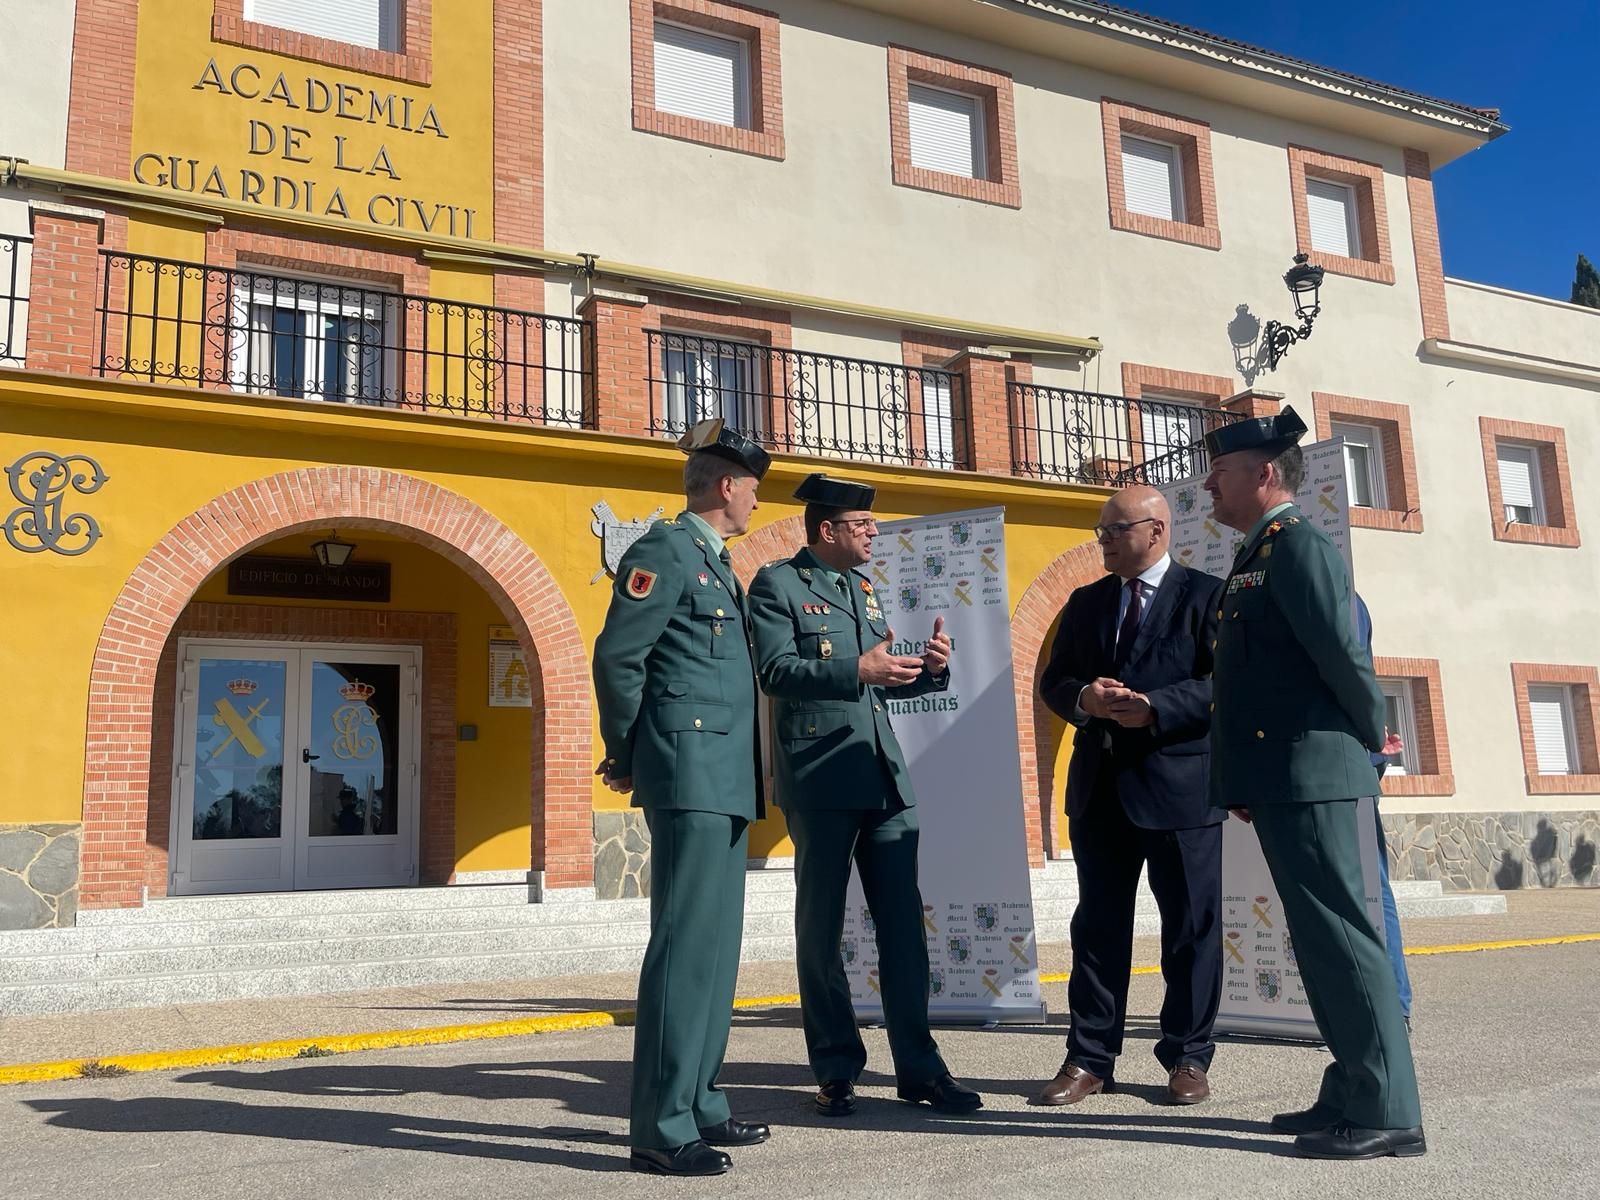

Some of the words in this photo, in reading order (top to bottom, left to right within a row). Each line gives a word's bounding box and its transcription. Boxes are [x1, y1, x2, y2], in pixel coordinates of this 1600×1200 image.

[192, 57, 450, 139] ACADEMIA
[248, 119, 314, 164] DE
[334, 135, 402, 181] LA
[133, 152, 351, 220] GUARDIA
[891, 694, 959, 715] uardias
